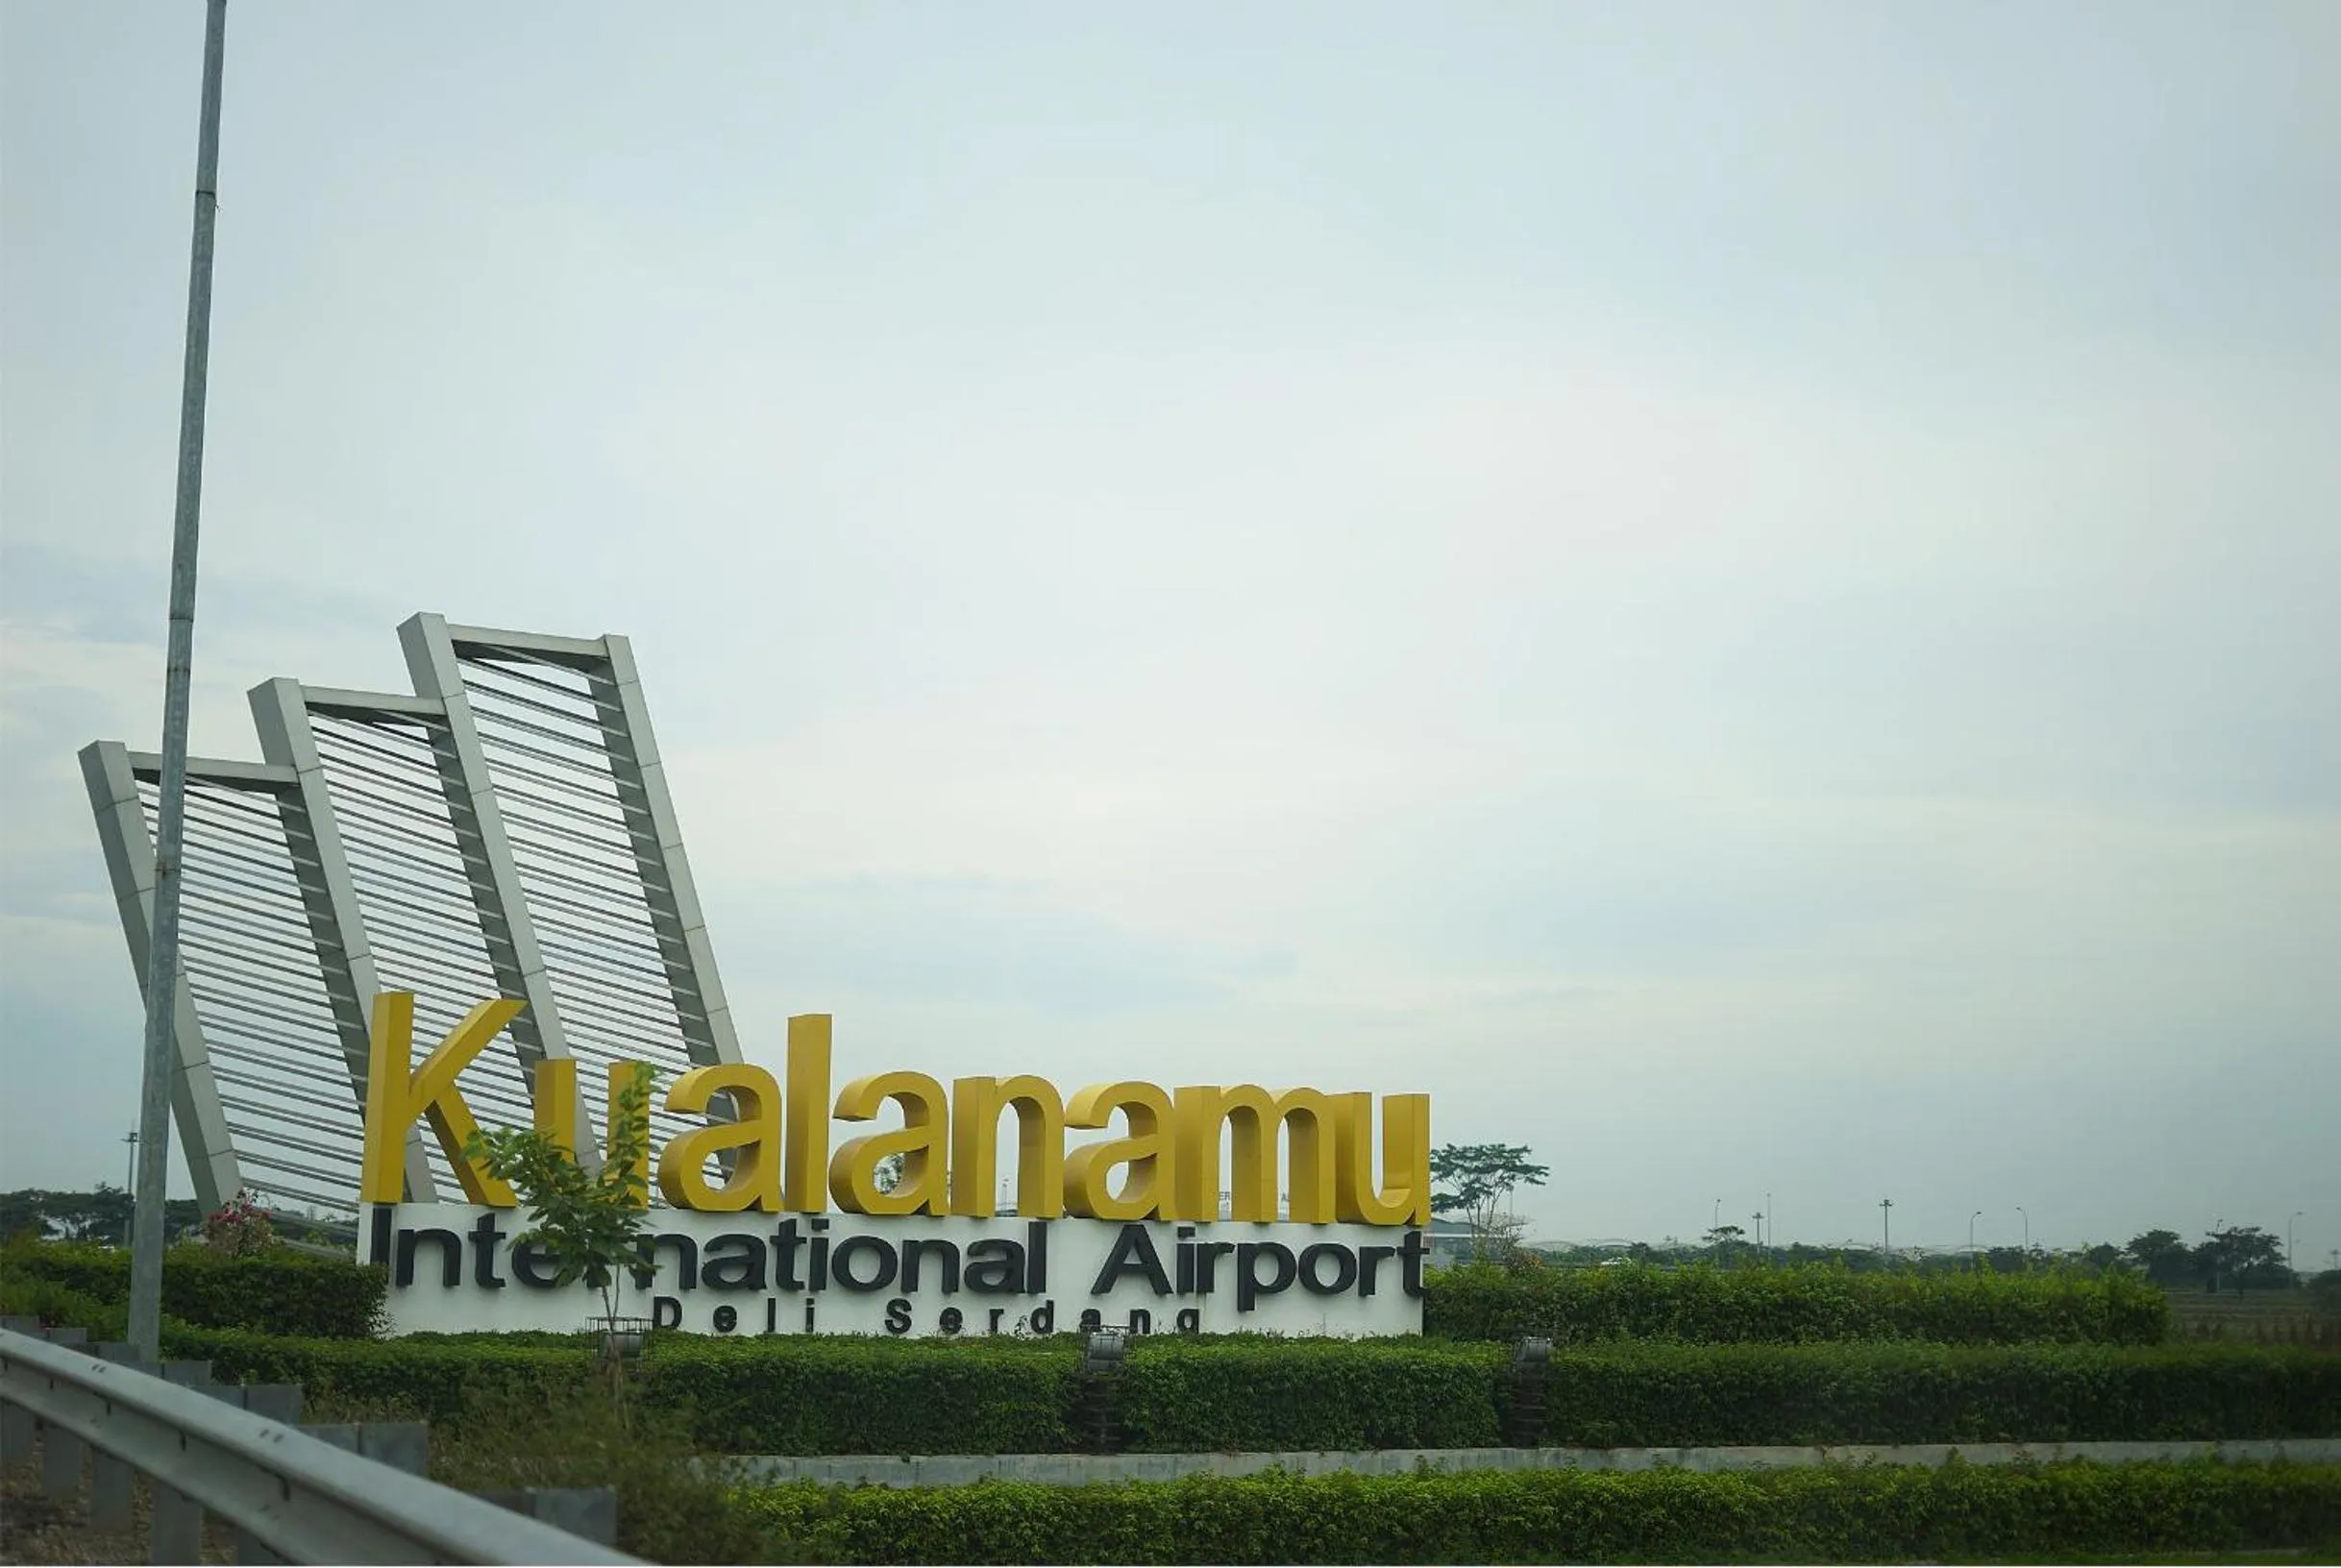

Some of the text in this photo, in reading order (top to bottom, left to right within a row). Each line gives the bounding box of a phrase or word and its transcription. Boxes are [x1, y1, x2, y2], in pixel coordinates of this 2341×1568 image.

[361, 992, 1431, 1226] Kualanamu
[370, 1208, 1431, 1311] Intenational Airport
[653, 1296, 1200, 1335] Deli Serdang
